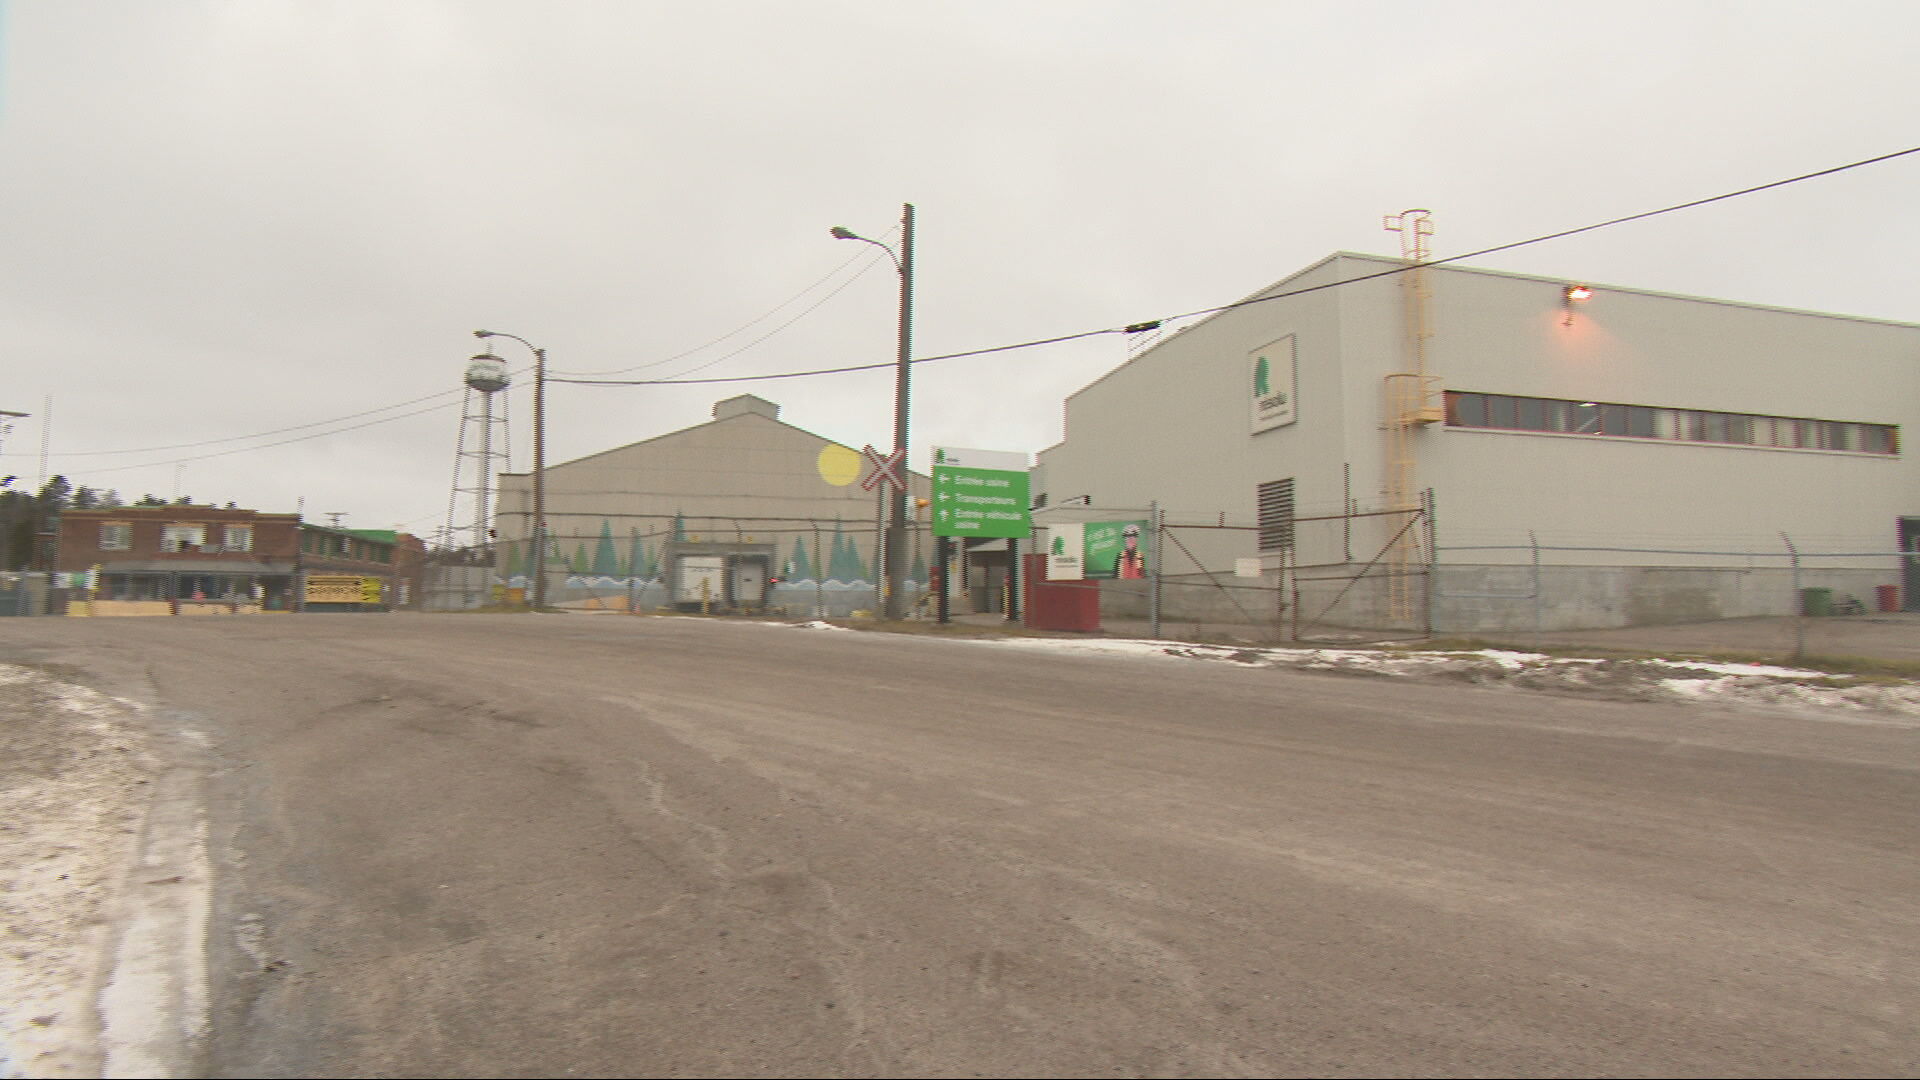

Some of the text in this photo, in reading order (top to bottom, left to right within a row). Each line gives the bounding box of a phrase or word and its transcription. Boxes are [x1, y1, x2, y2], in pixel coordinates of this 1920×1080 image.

[985, 478, 1011, 489] usine
[953, 492, 1017, 506] Transporteurs
[953, 521, 981, 530] usine
